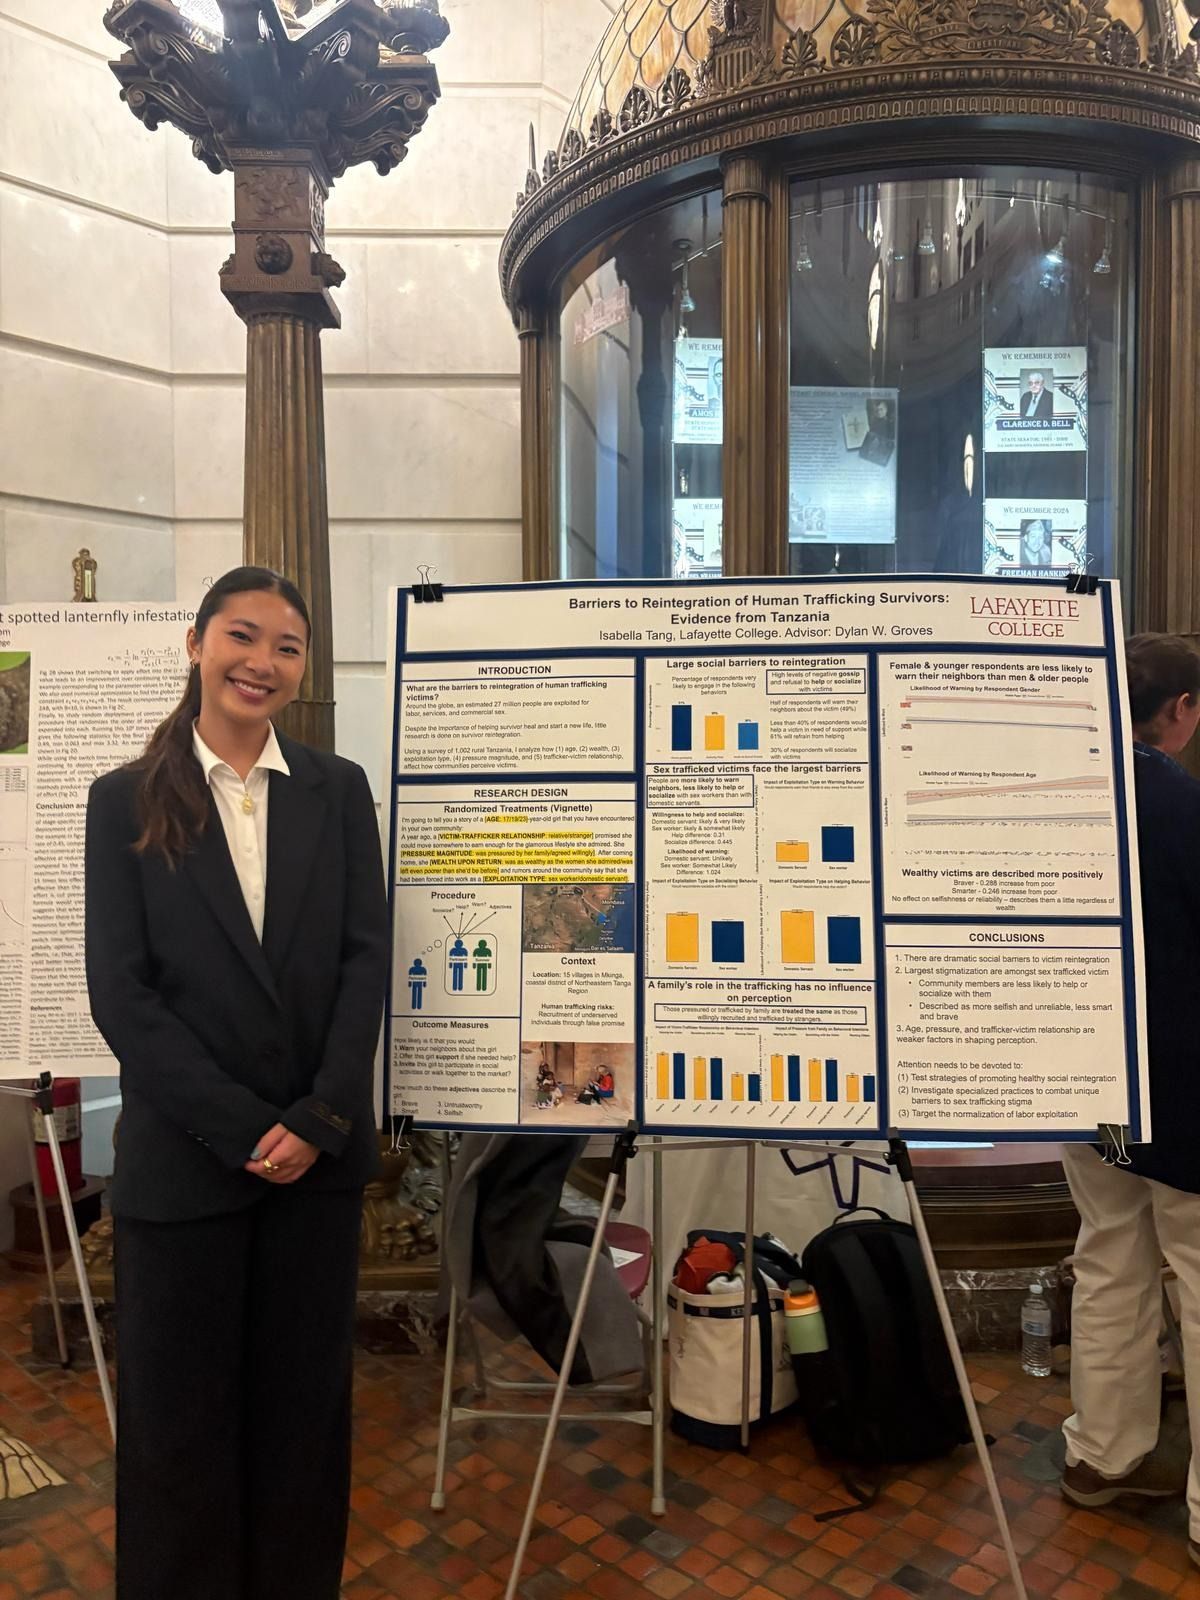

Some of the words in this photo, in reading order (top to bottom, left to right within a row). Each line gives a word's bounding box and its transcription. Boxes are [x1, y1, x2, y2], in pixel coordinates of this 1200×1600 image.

[569, 597, 621, 609] Barriers
[625, 598, 638, 608] to
[642, 596, 731, 610] Reintegration
[734, 595, 749, 606] of
[752, 594, 799, 606] Human
[803, 593, 876, 607] Trafficking
[879, 591, 949, 604] Survivors:
[971, 596, 1079, 617] LAFAYETTE
[8, 610, 60, 625] spotted
[64, 610, 129, 624] lanternfly
[670, 613, 732, 624] Evidence
[735, 612, 767, 623] from
[771, 611, 830, 622] Tanzania
[599, 630, 643, 641] Isabella
[645, 630, 676, 642] Tang,
[679, 628, 732, 642] Lafayette
[735, 627, 782, 641] College.
[784, 627, 831, 638] Advisor:
[835, 626, 869, 639] Dylan
[872, 626, 887, 636] W.
[890, 625, 933, 636] Groves
[988, 622, 1064, 638] COLLEGE
[666, 660, 694, 670] Large
[696, 659, 726, 667] social
[728, 658, 767, 667] barriers
[782, 657, 846, 668] reintegration
[932, 663, 969, 673] younger
[971, 663, 1025, 673] respondents
[1061, 664, 1083, 674] likely
[478, 666, 552, 674] INTRODUCTION
[941, 673, 985, 682] neighbors
[1061, 675, 1089, 684] people
[489, 683, 535, 691] reintegration
[570, 681, 608, 689] trafficking
[653, 766, 669, 774] Sex
[672, 765, 715, 774] trafficked
[717, 765, 750, 774] victims
[752, 765, 771, 774] face
[791, 765, 823, 774] largest
[473, 789, 529, 797] RESEARCH
[530, 788, 568, 796] DESIGN
[550, 804, 593, 813] (Vignette)
[901, 868, 939, 878] Wealthy
[991, 869, 1035, 878] described
[1061, 870, 1104, 880] positively
[969, 933, 1045, 942] CONCLUSIONS
[1064, 956, 1110, 964] reintegration
[904, 966, 934, 975] Largest
[935, 968, 989, 976] stigmatization
[1004, 968, 1037, 976] amongst
[657, 981, 693, 991] family's
[744, 982, 792, 992] trafficking
[828, 983, 872, 992] influence
[741, 994, 793, 1004] perception
[564, 1003, 596, 1012] trafficking
[897, 1074, 909, 1082] (1)
[929, 1074, 968, 1083] strategies
[978, 1075, 1017, 1084] promoting
[1018, 1074, 1046, 1083] healthy
[1070, 1075, 1117, 1084] reintegration
